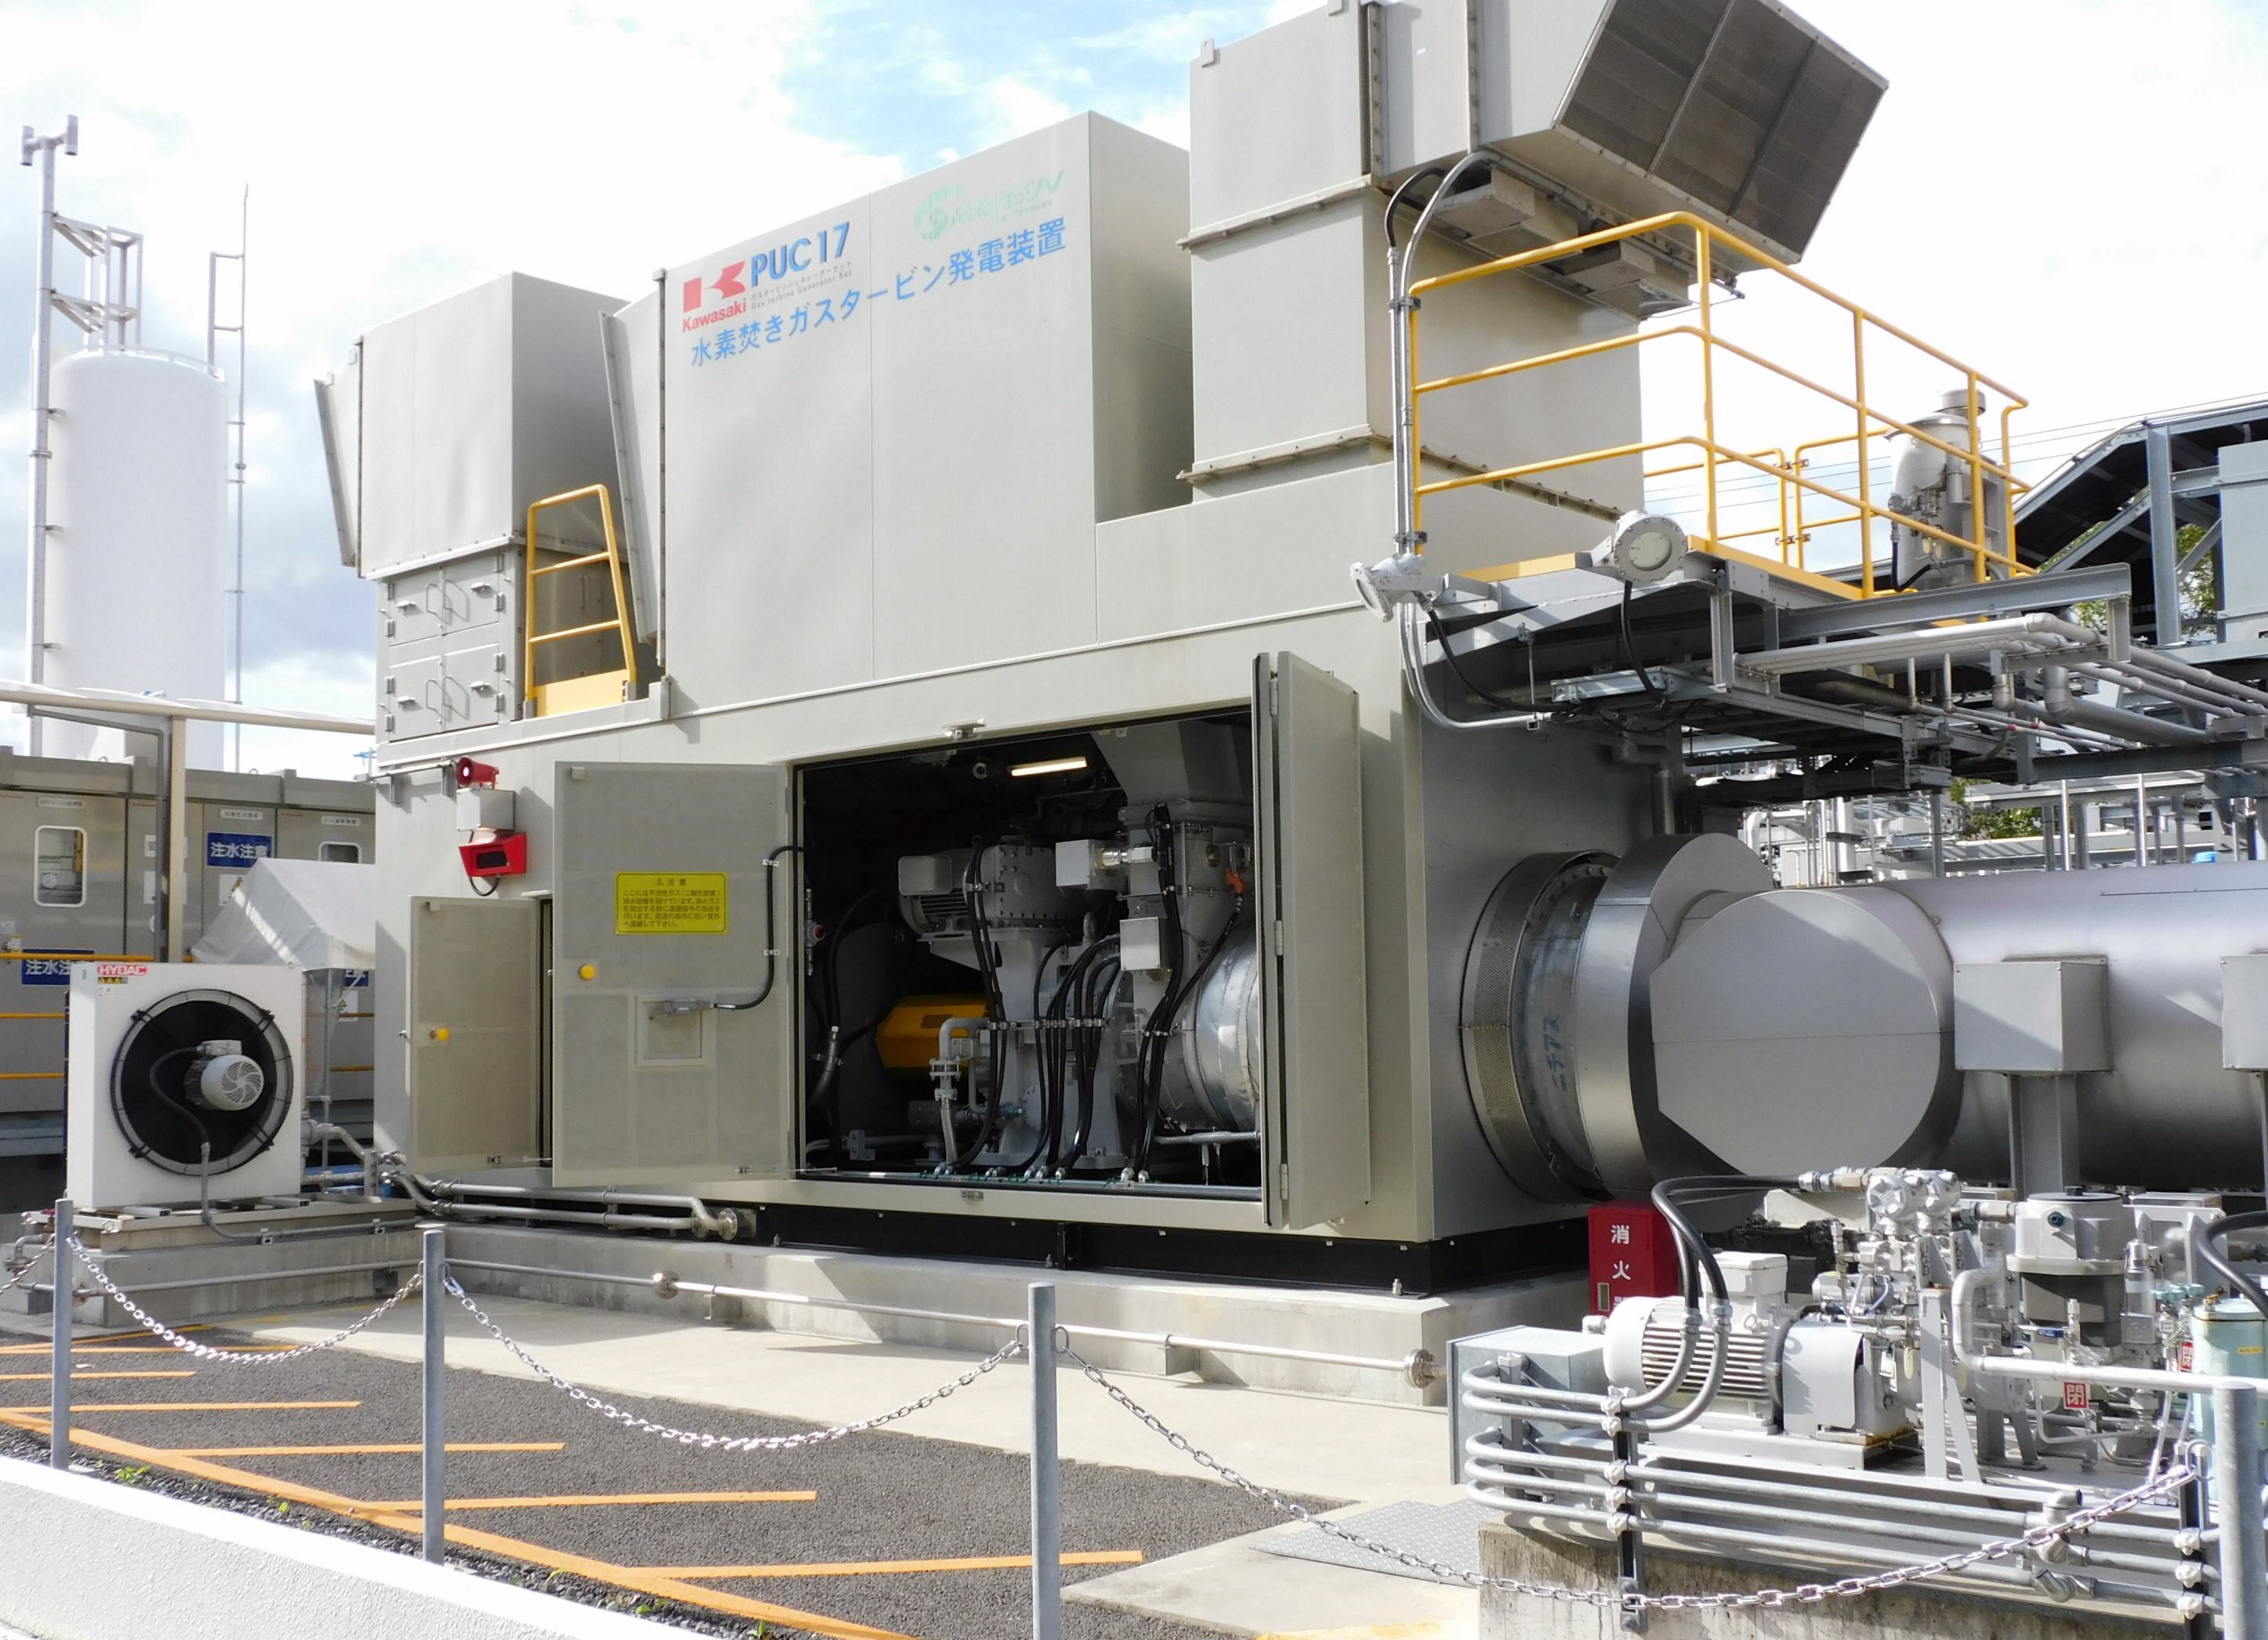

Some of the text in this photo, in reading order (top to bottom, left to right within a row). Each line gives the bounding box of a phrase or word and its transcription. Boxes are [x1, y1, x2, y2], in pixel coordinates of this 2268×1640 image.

[690, 217, 1067, 367] 水素焚きガスタービン発電装置
[752, 301, 765, 310] Gas
[797, 275, 835, 293] Generator
[839, 270, 852, 280] Set
[683, 298, 747, 332] Kawasaki
[100, 965, 147, 976] HYDAC
[2066, 1384, 2085, 1406] 閉
